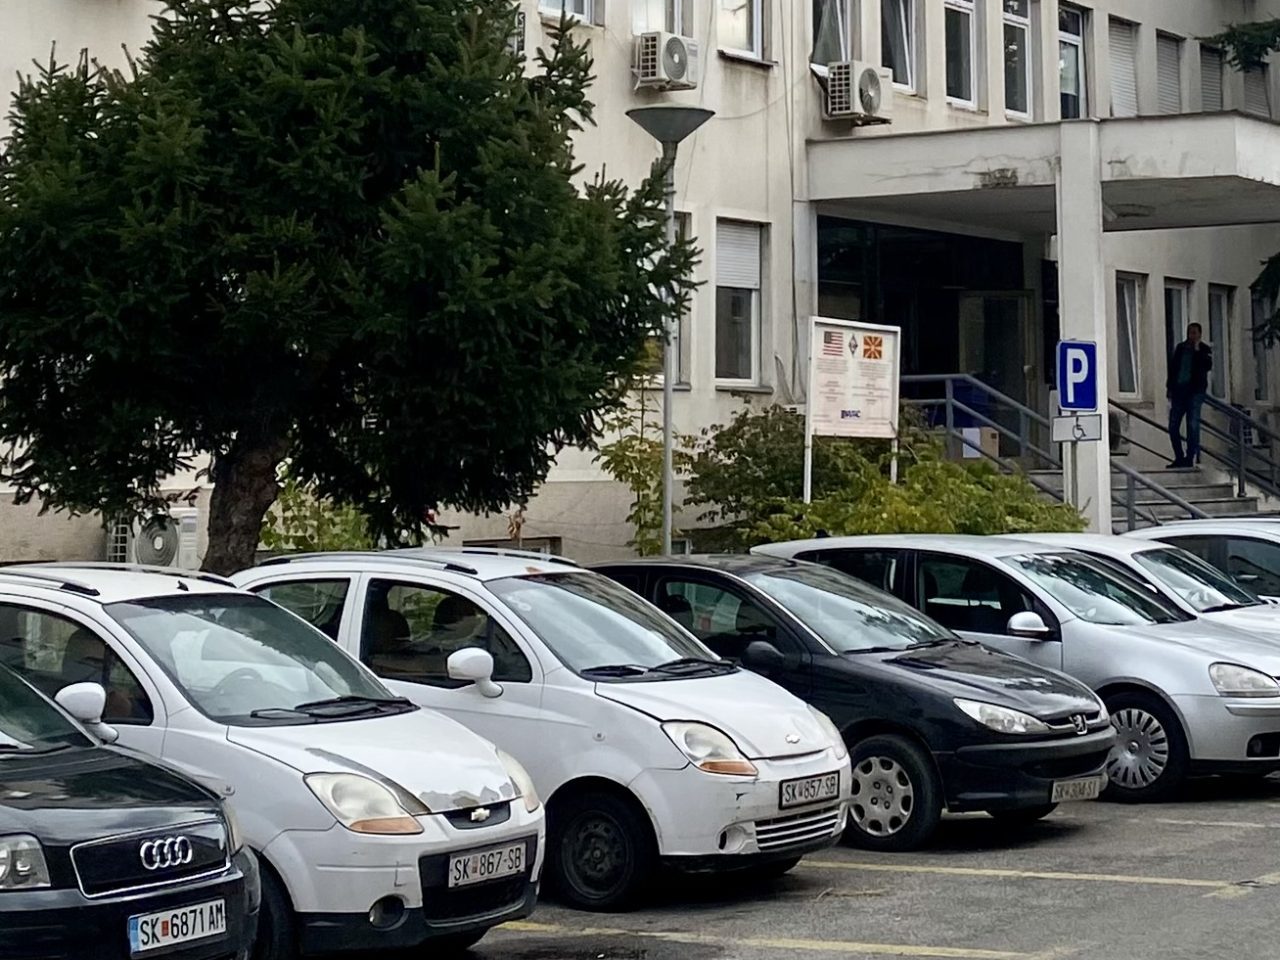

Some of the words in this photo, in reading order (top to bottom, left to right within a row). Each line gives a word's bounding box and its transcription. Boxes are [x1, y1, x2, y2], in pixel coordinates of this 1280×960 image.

[1066, 347, 1089, 403] P
[454, 858, 470, 881] SK
[140, 917, 160, 946] SK
